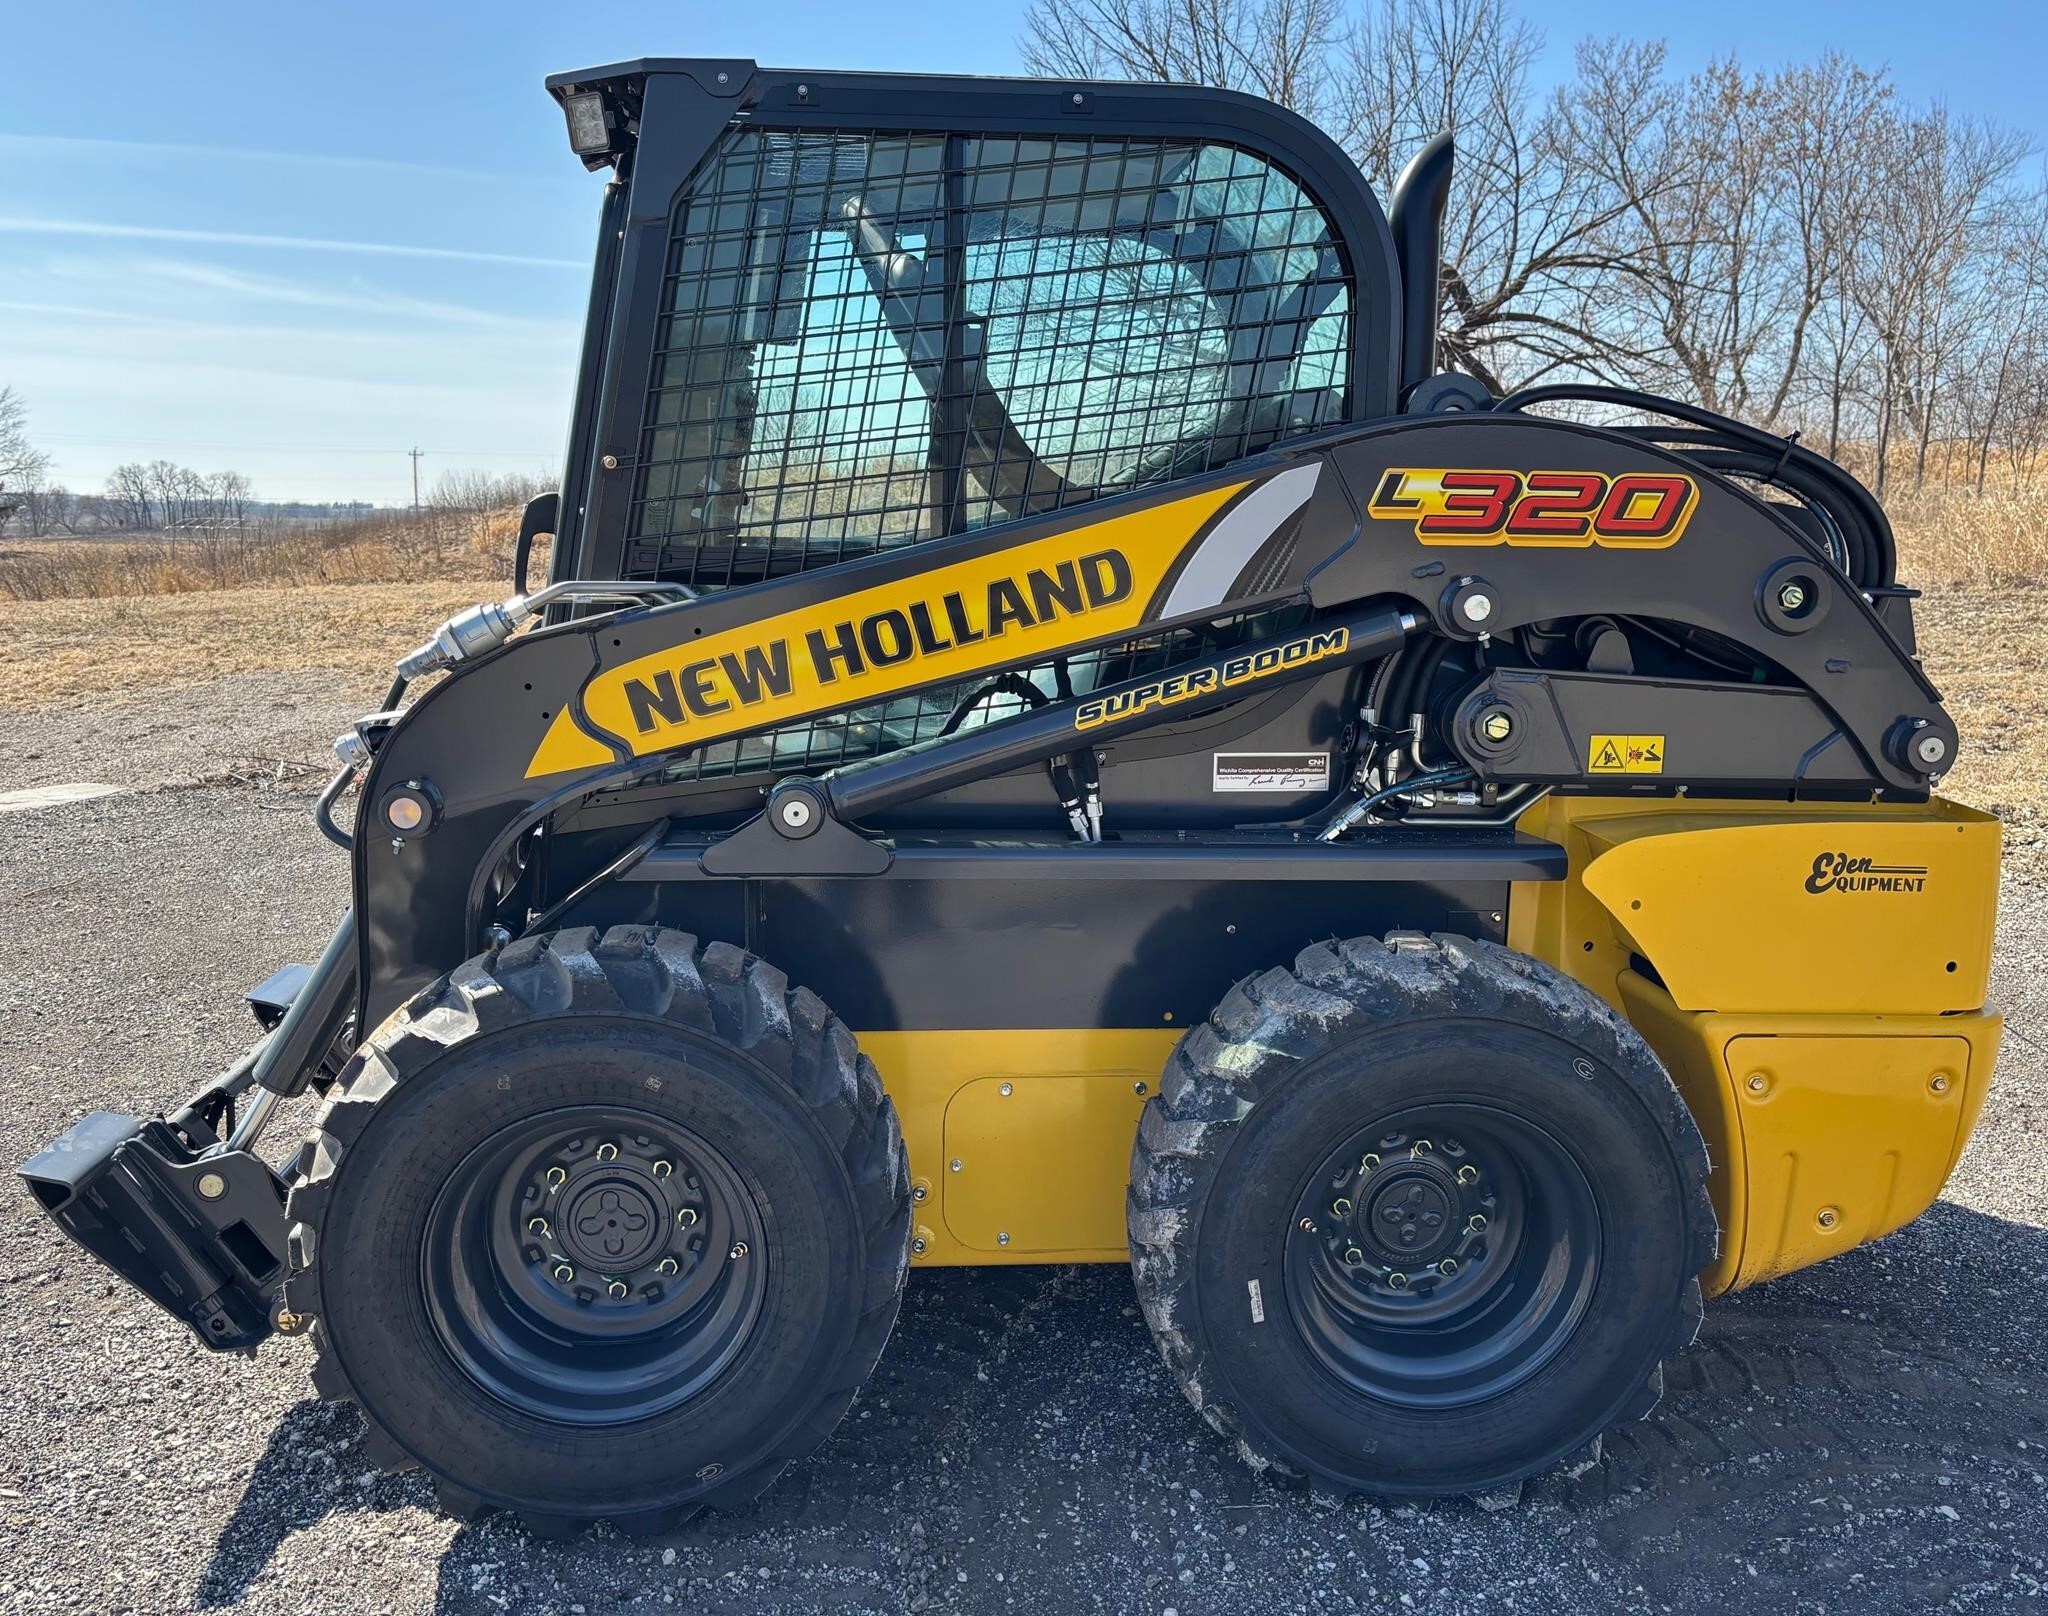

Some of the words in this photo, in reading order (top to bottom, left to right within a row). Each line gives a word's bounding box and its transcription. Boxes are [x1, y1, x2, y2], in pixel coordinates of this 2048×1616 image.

[1369, 468, 1699, 548] L320
[623, 638, 793, 735] NEW
[804, 548, 1134, 685] HOLLAND
[1076, 667, 1217, 730] SUPER
[1222, 627, 1349, 686] BOOM
[1805, 852, 1872, 894] Eden
[1573, 1057, 1595, 1080] G
